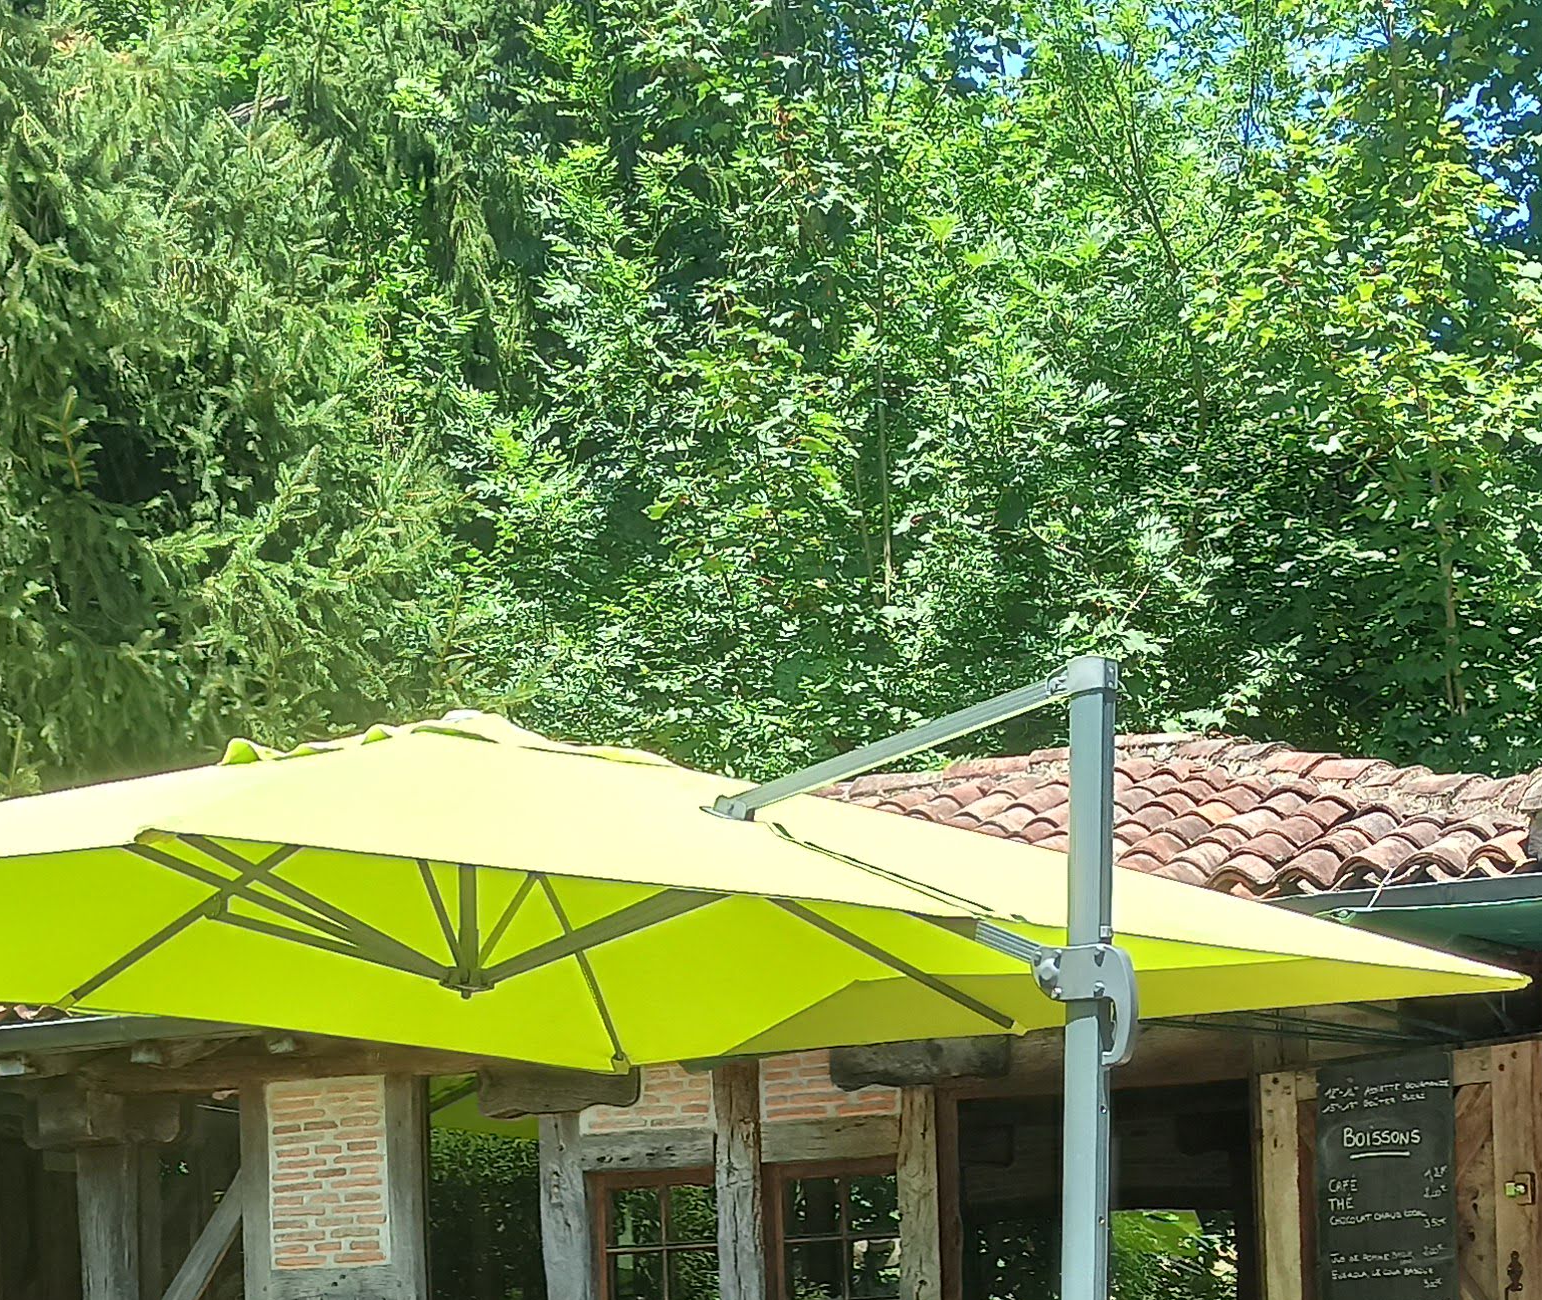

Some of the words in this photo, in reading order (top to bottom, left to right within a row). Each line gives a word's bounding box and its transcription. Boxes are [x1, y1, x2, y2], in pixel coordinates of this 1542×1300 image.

[1343, 1126, 1421, 1148] BOISSONS
[1328, 1173, 1358, 1193] CAFÉ
[1327, 1193, 1354, 1211] THÉ
[1329, 1213, 1373, 1226] CHOCOLAT
